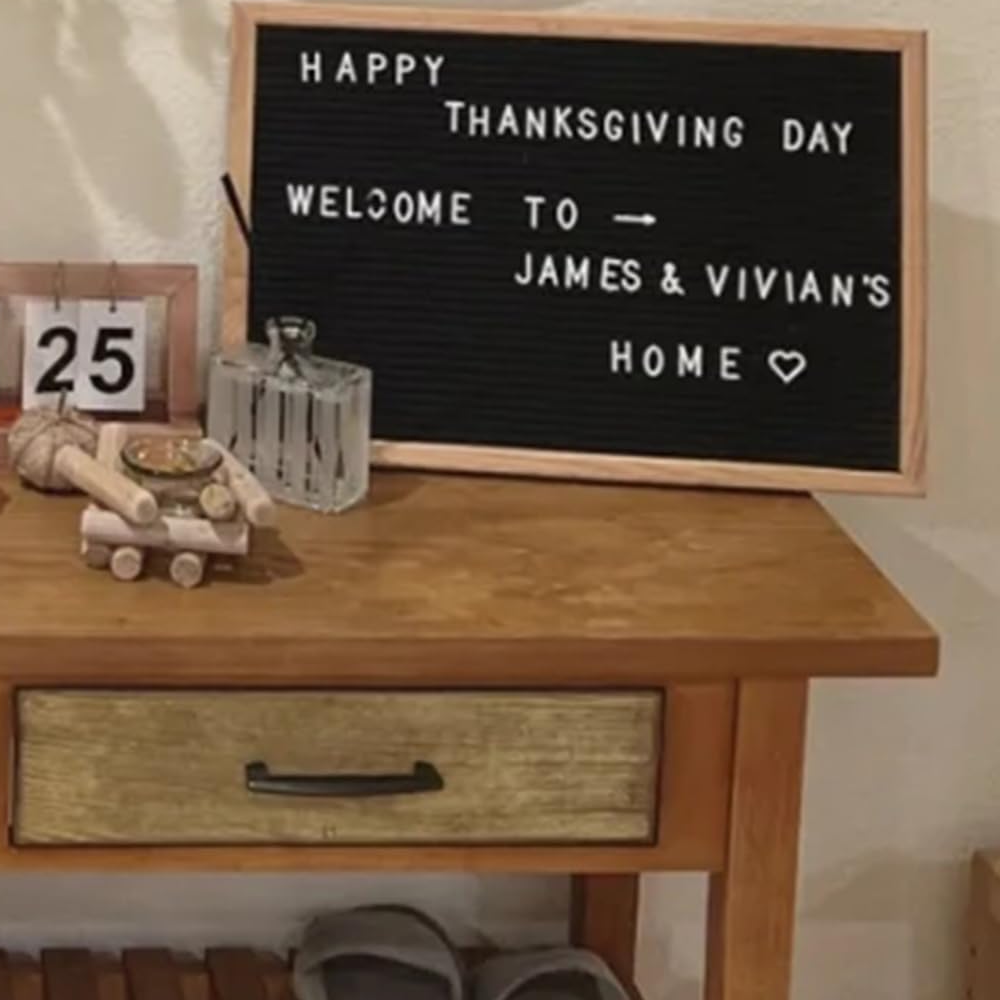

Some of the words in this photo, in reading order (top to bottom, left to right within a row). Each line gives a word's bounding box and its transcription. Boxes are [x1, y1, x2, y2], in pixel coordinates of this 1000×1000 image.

[300, 51, 445, 87] HAPPY
[443, 99, 744, 149] THANKSGIVING
[782, 118, 853, 155] DAY
[523, 195, 579, 231] TO
[513, 252, 643, 293] JAMES
[659, 261, 686, 297] &
[705, 263, 891, 309] VIVIAN'S
[34, 326, 135, 395] 25
[610, 339, 742, 381] HOME
